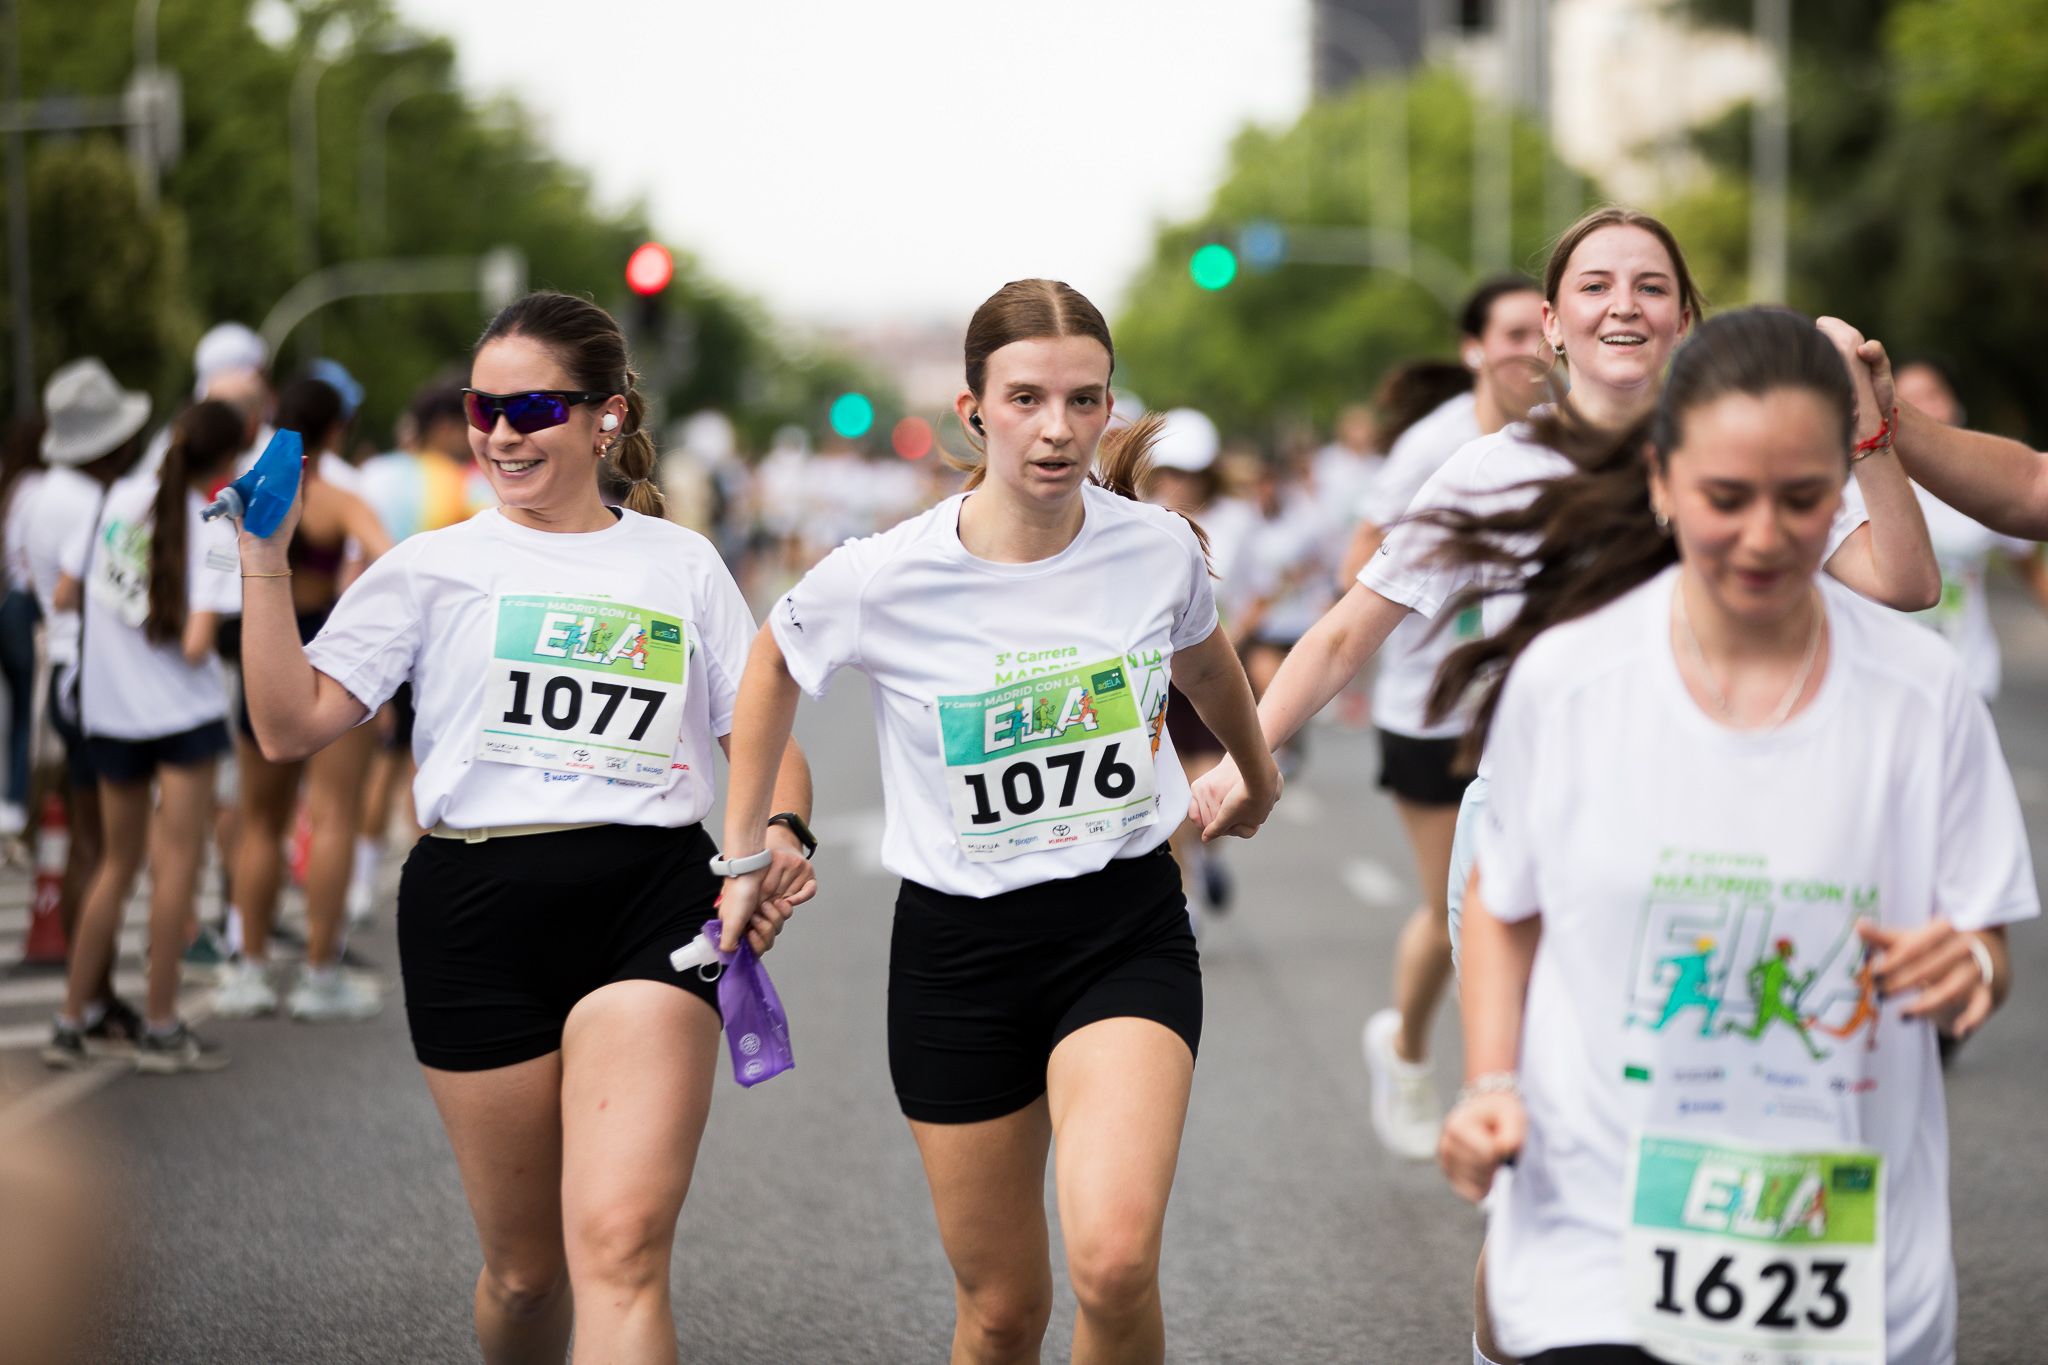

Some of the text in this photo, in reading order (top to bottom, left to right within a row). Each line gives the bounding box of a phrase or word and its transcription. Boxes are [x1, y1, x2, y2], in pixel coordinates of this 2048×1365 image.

[548, 602, 598, 614] MADRID
[599, 607, 626, 619] CON
[627, 609, 641, 621] LA
[533, 612, 646, 670] ELA
[1016, 645, 1079, 665] Carrera
[1142, 648, 1163, 667] LA
[502, 670, 668, 742] 1077
[984, 685, 1033, 707] MADRID
[1034, 679, 1063, 693] CON
[1063, 674, 1081, 687] LA
[983, 685, 1100, 755] ELA
[963, 741, 1137, 825] 1076
[1088, 826, 1105, 835] LIFE
[1127, 810, 1149, 823] MADRID
[1652, 875, 1775, 898] MADRID
[1780, 881, 1845, 902] CON
[1681, 1165, 1828, 1240] ELA
[1653, 1247, 1851, 1332] 1623
